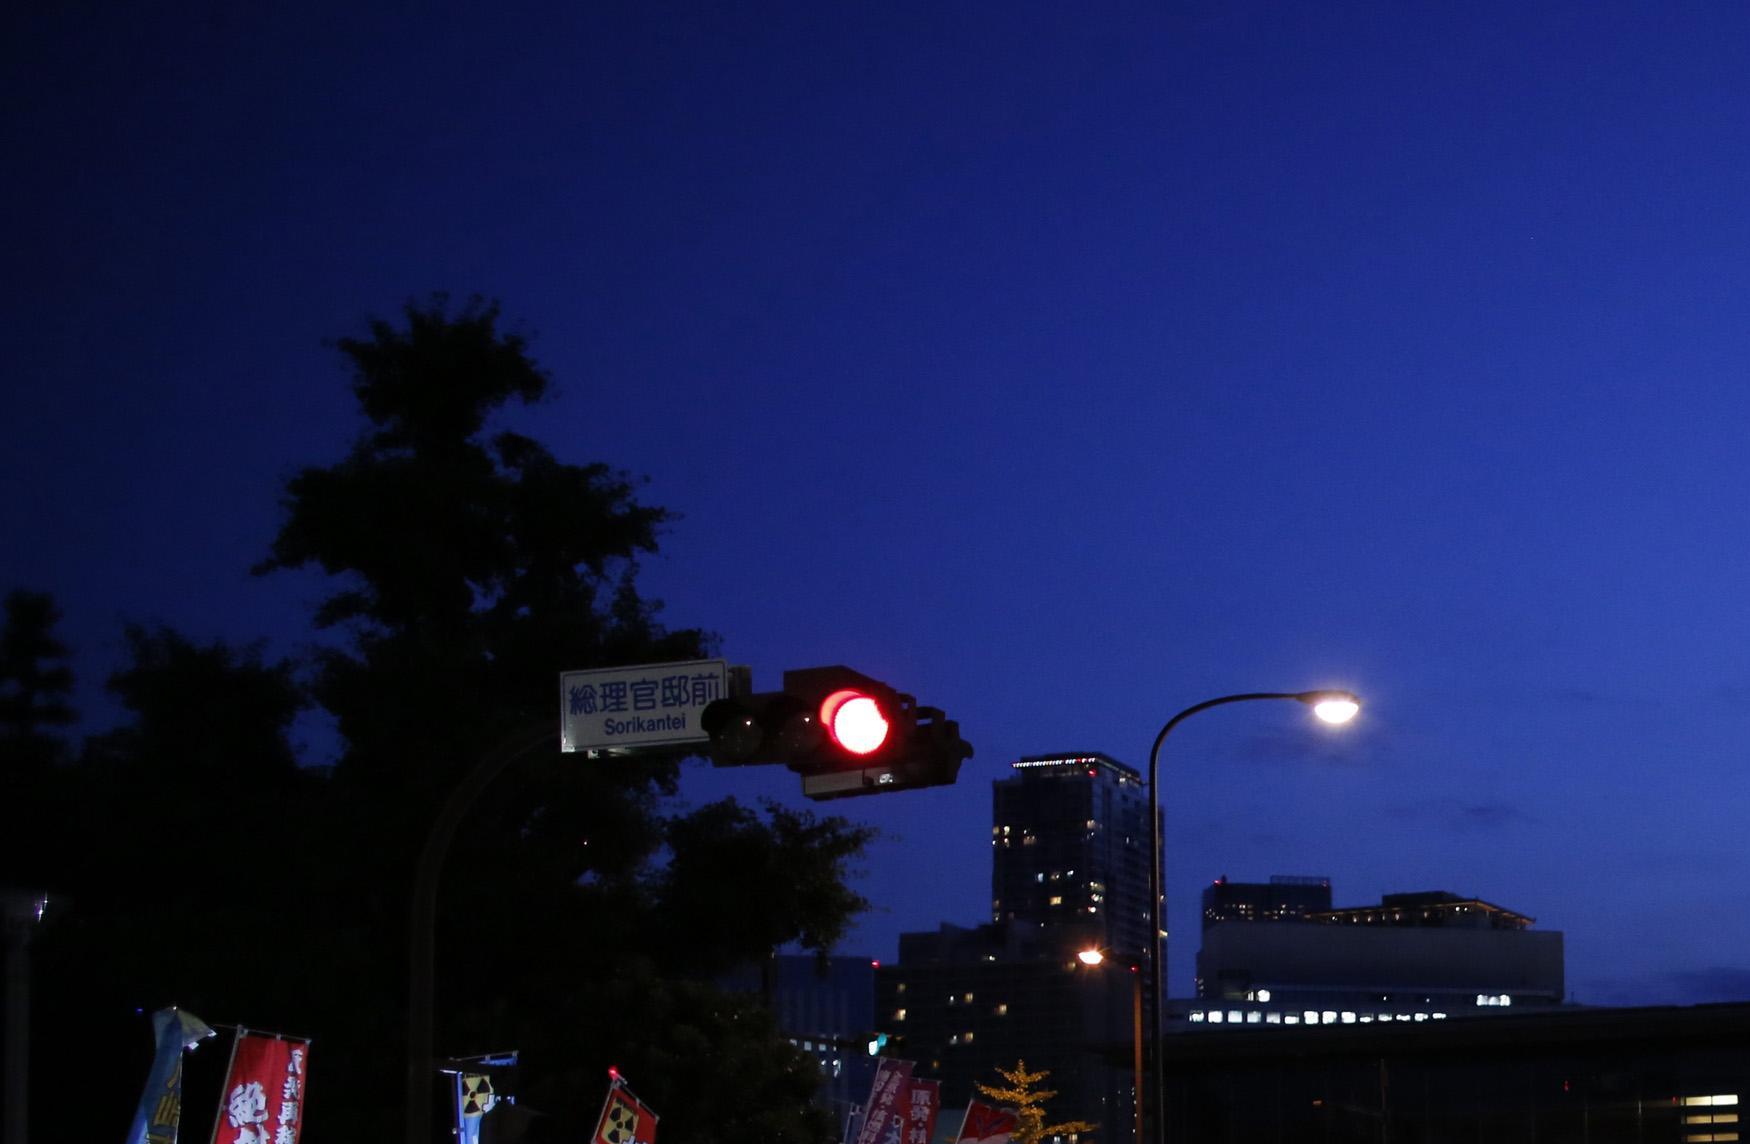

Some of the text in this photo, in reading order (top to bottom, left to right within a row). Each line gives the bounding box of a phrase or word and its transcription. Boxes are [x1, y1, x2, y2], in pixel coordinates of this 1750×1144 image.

[569, 673, 719, 717] 総理官邸前
[604, 713, 686, 735] Sorikantei
